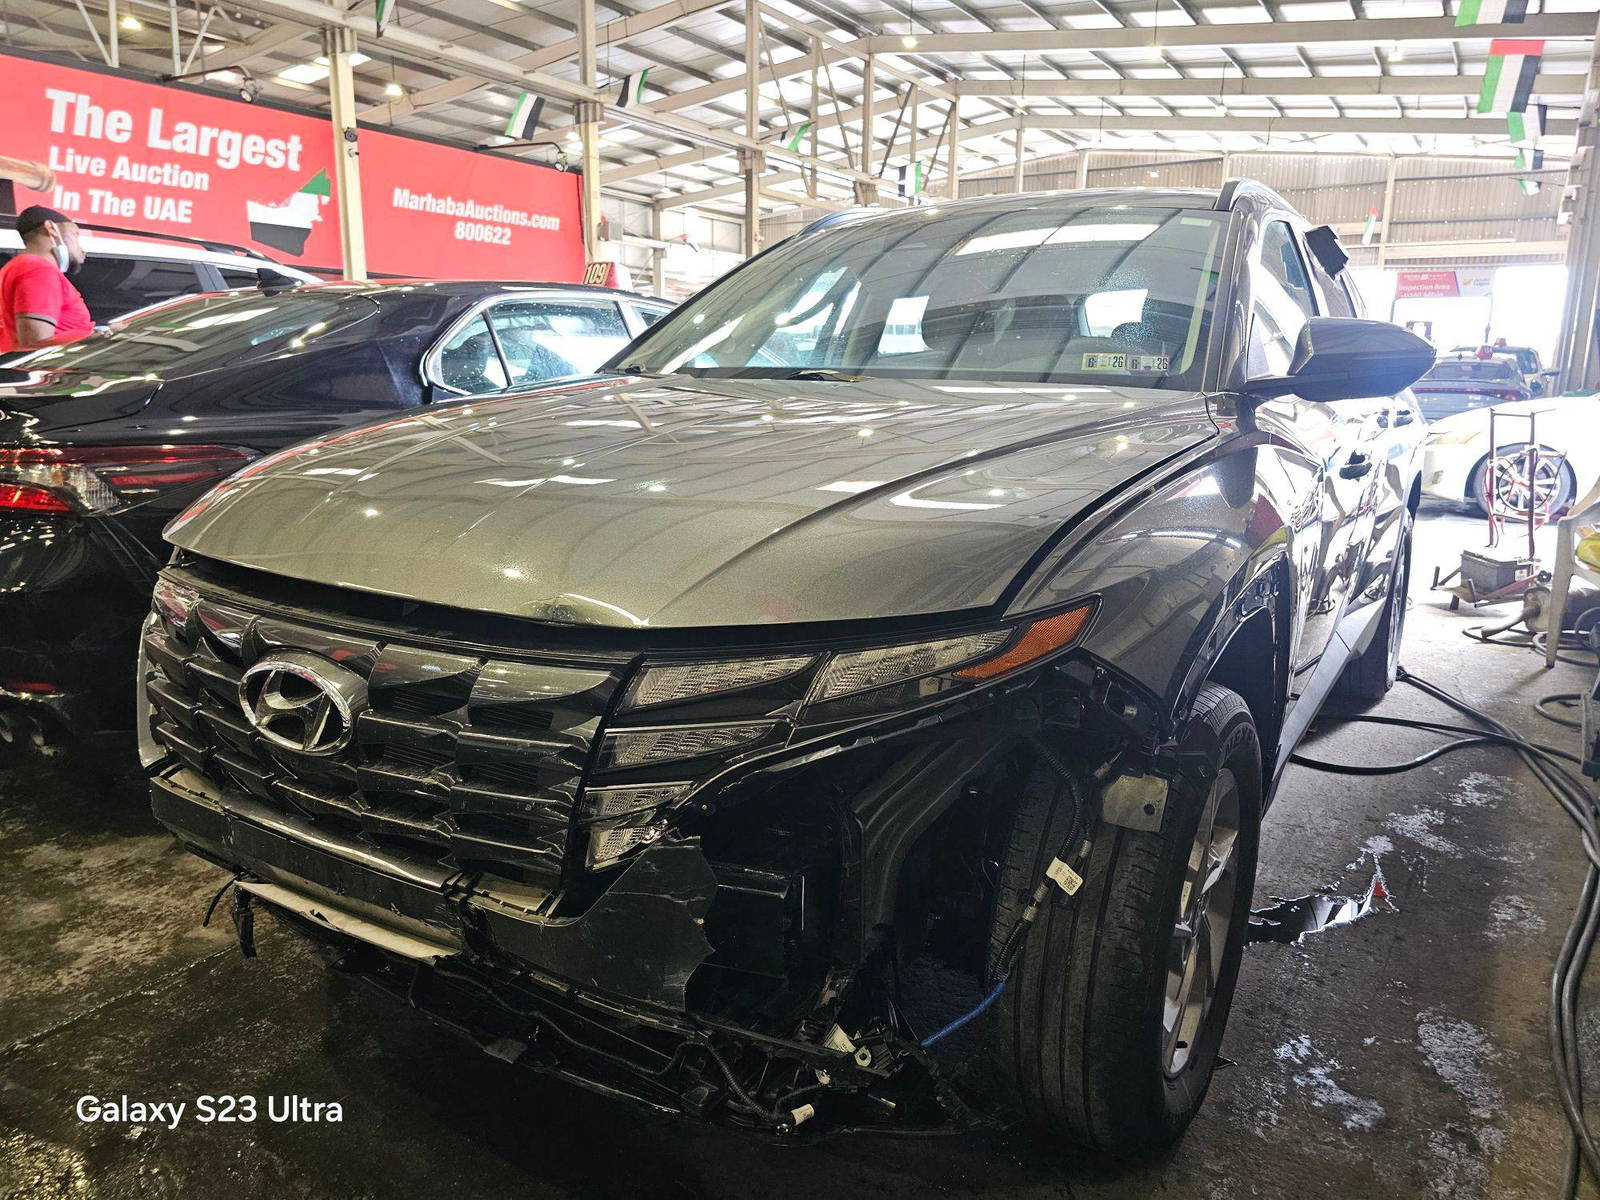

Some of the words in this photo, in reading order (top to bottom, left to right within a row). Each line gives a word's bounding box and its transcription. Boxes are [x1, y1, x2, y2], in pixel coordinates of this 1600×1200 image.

[45, 87, 133, 144] The
[147, 107, 303, 172] Largest
[48, 145, 107, 179] Live
[112, 155, 210, 192] Auction
[53, 185, 80, 211] In
[88, 189, 136, 218] The
[144, 196, 194, 224] UAE
[393, 188, 560, 231] MarhabaAuctions.com
[454, 220, 512, 246] 800622
[584, 264, 606, 285] 109
